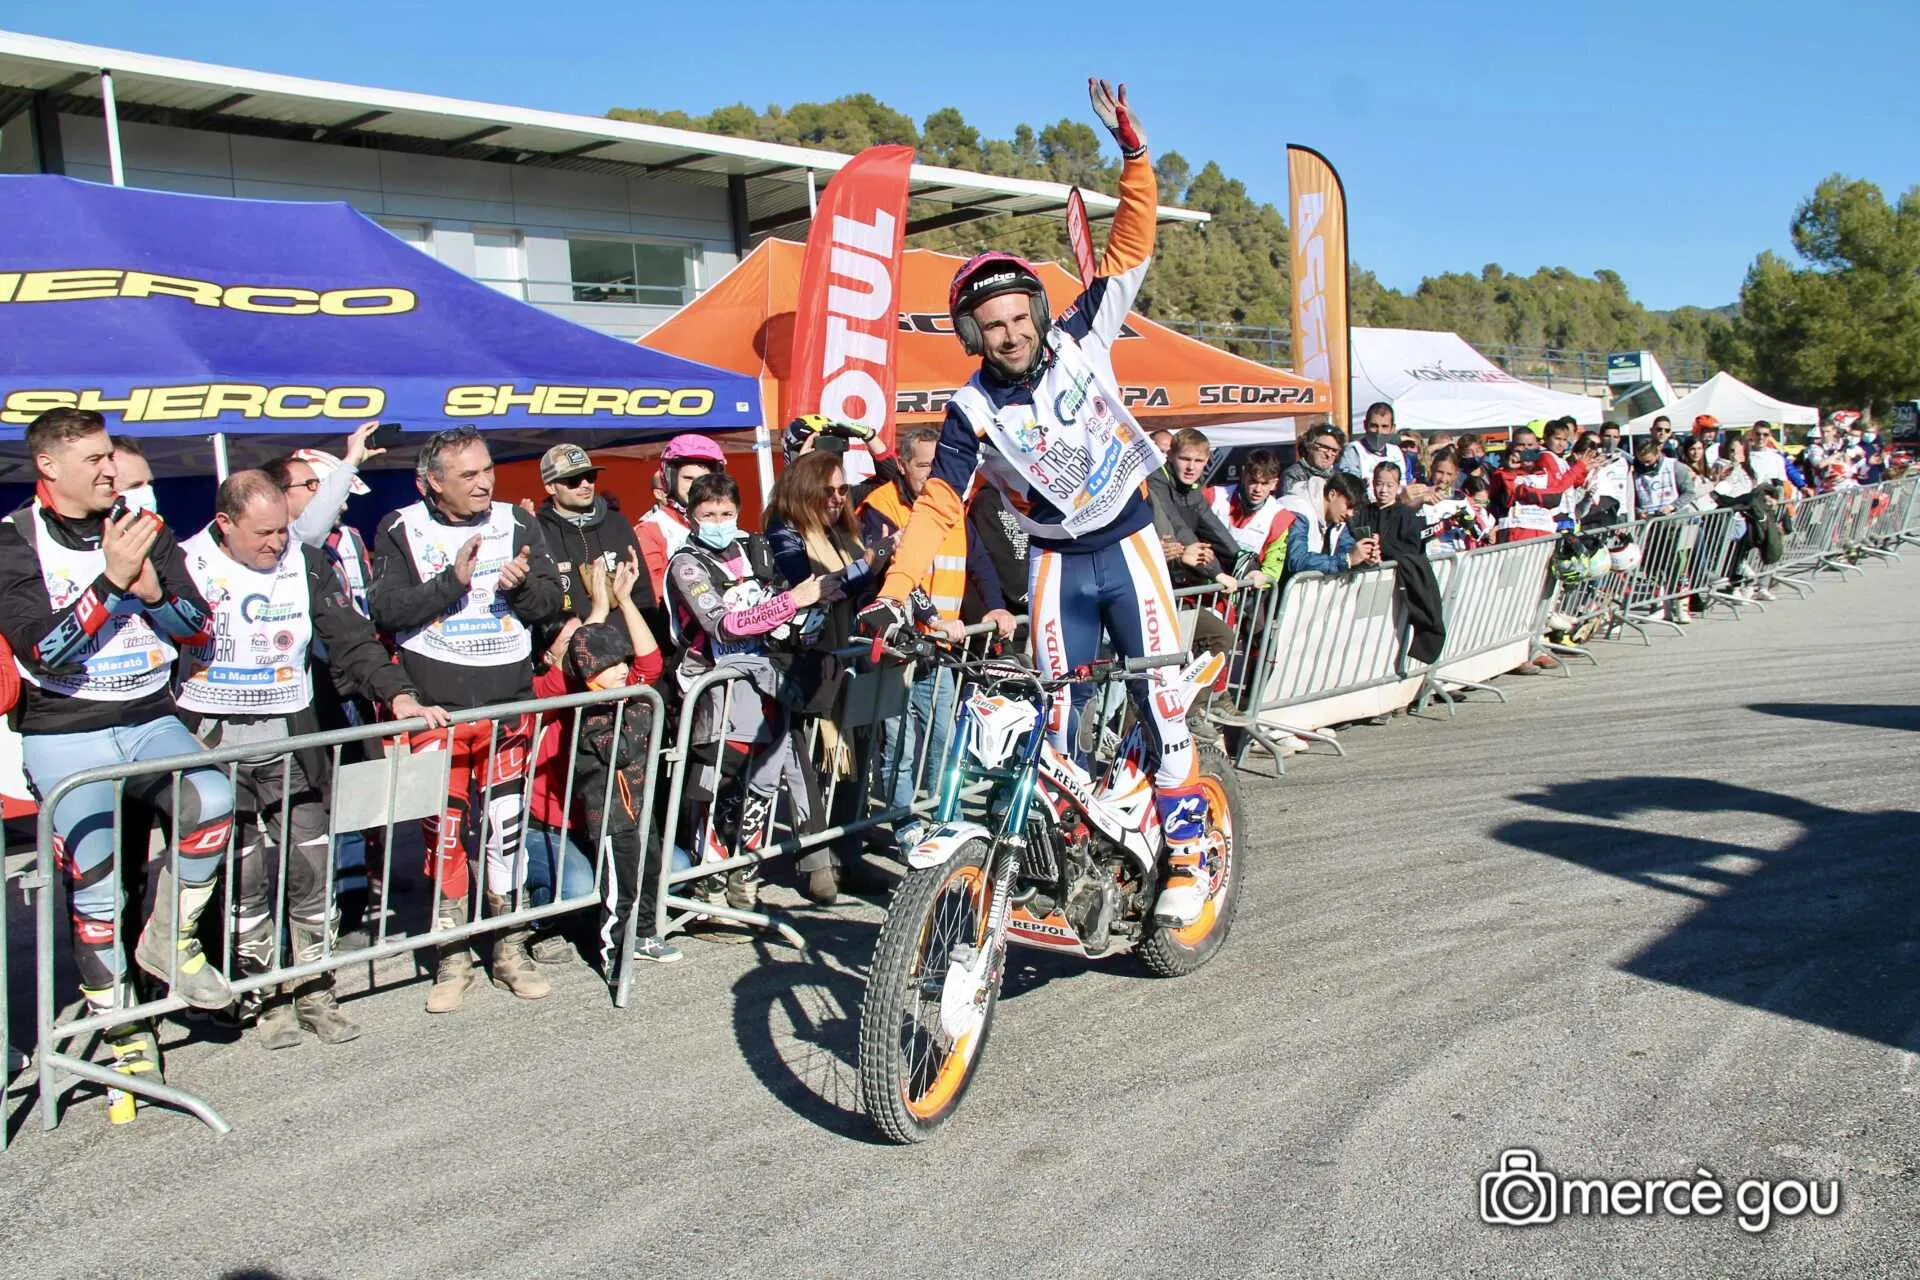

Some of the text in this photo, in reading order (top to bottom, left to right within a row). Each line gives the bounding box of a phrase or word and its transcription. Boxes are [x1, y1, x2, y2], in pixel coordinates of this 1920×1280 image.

[0, 269, 417, 315] ERCO
[0, 384, 715, 424] SHERCO SHERCO
[1199, 384, 1316, 405] SCORPA
[737, 601, 790, 628] CAMBRILS
[213, 670, 270, 681] La Marató
[1013, 920, 1066, 936] REPSOL
